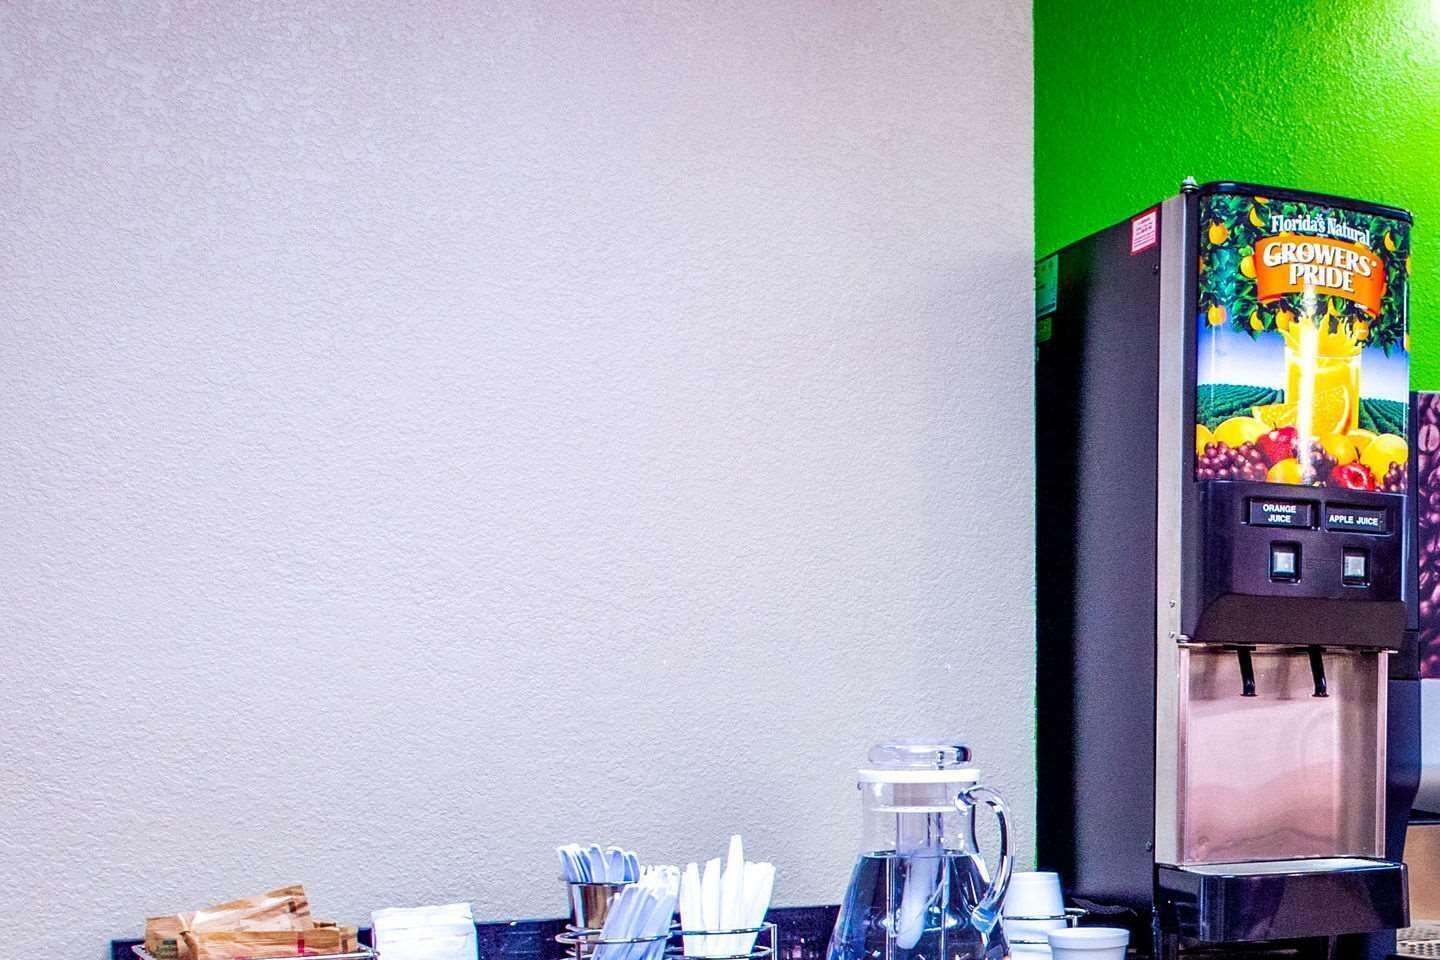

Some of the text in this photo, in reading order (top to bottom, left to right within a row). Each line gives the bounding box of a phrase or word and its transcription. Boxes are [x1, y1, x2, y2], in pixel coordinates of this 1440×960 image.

[1271, 213, 1371, 246] Florida's Natural
[1289, 264, 1355, 293] PRIDE
[1263, 503, 1297, 514] ORANGE
[1268, 514, 1292, 523] JUICE
[1328, 515, 1379, 527] APPLE JUICE
